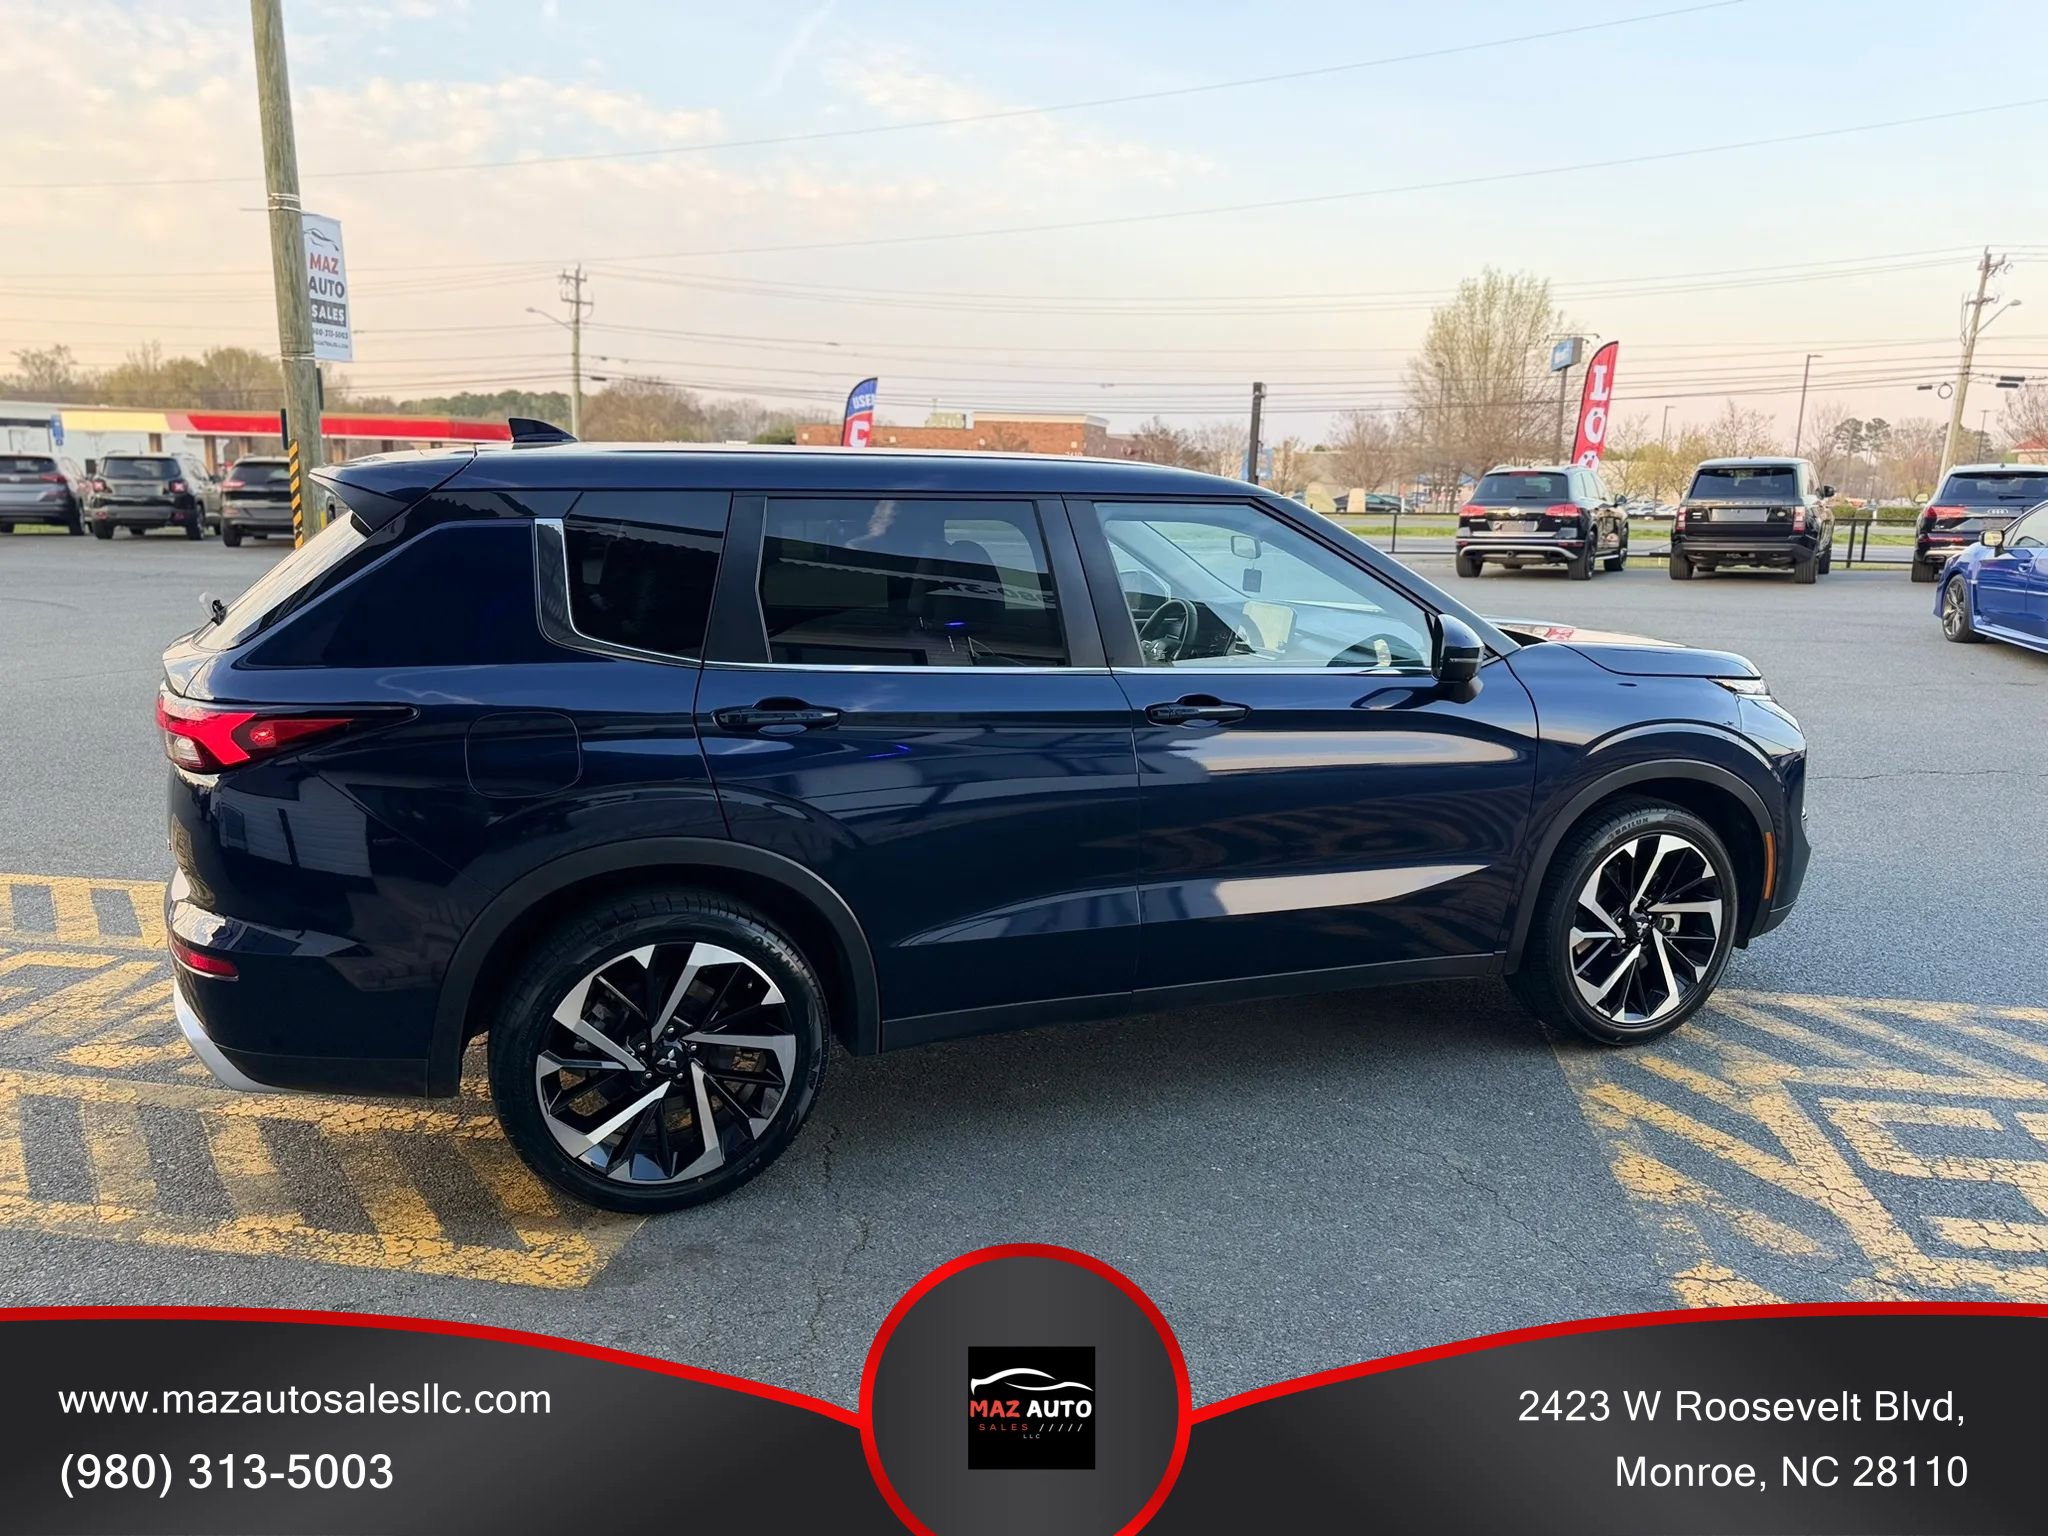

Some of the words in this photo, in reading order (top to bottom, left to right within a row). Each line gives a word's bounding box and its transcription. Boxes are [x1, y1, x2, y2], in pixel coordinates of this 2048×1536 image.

[309, 252, 339, 275] MAZ
[308, 276, 345, 298] AUTO
[311, 304, 345, 322] SALES
